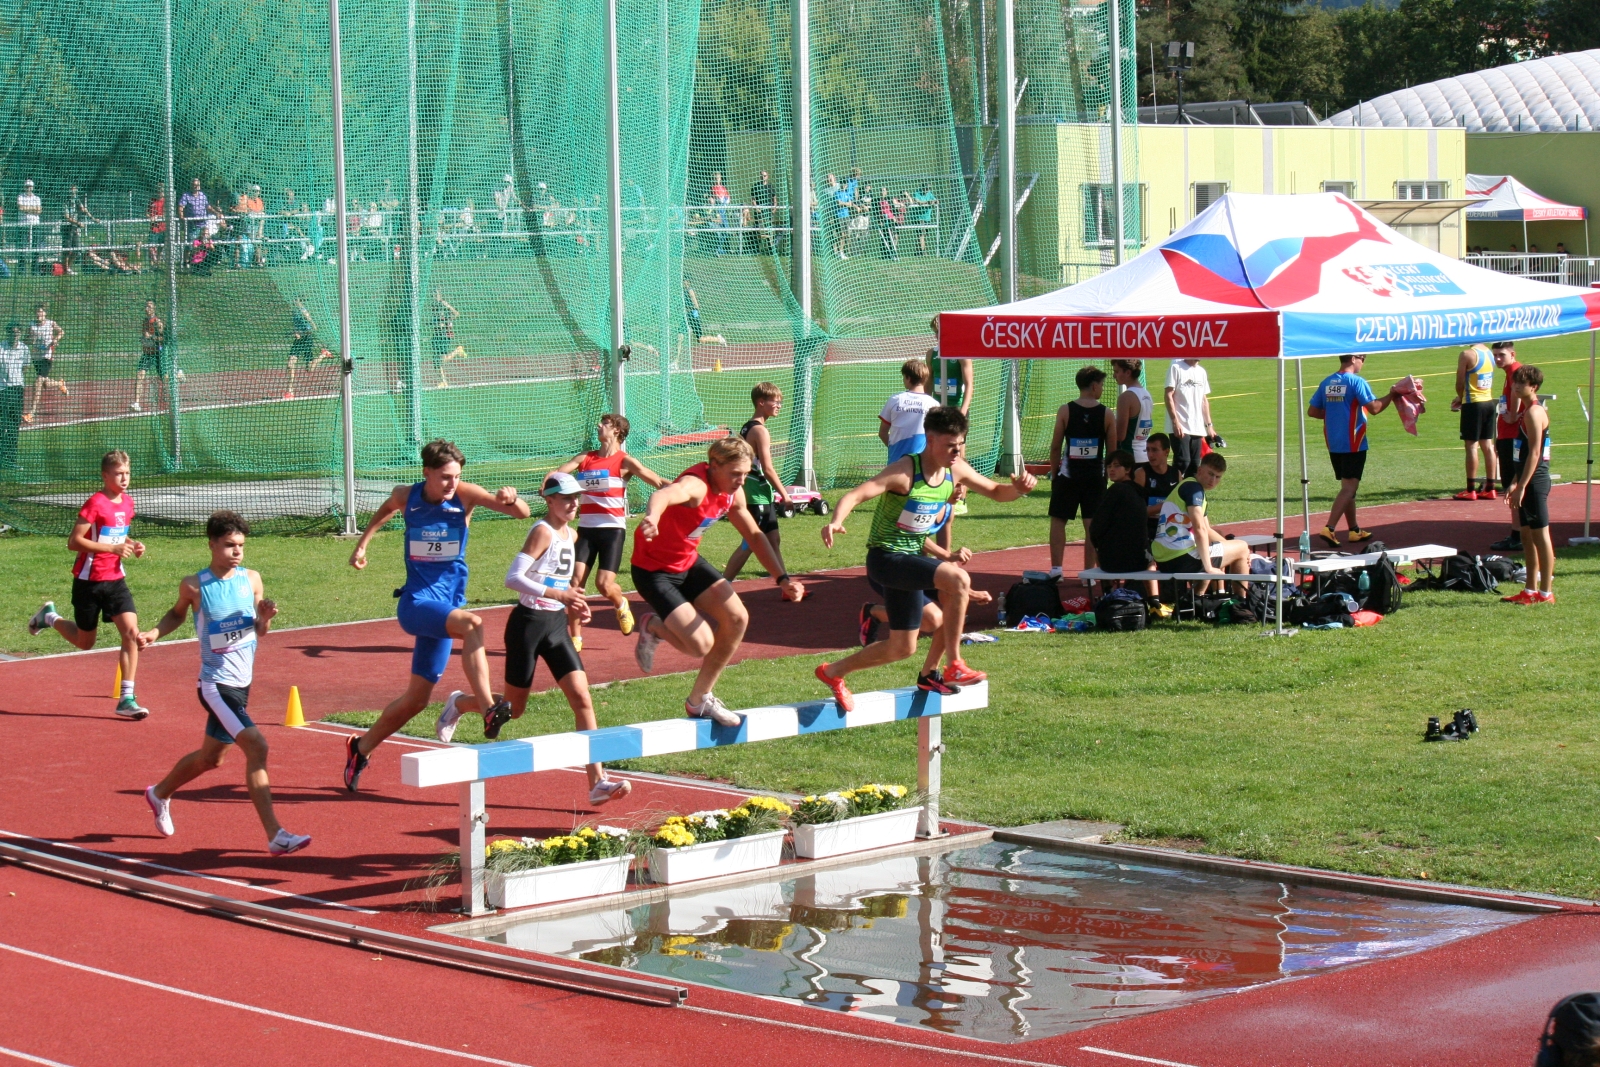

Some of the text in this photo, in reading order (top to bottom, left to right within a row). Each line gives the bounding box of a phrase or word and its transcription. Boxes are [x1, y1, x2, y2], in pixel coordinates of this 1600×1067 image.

[1390, 264, 1421, 274] ČESKÝ
[1402, 272, 1451, 284] ATLETICKÝ
[1413, 284, 1441, 293] SVAZ
[1355, 303, 1562, 343] CZECH ATHLETIC FEDERATION
[980, 316, 1228, 348] ČESKÝ ATLETICKÝ SVAZ
[1328, 385, 1341, 393] 548
[1079, 447, 1090, 455] 15
[585, 479, 600, 487] 544
[913, 514, 932, 523] 452
[427, 542, 442, 551] 78
[554, 548, 572, 576] S
[219, 619, 238, 628] ČESKÁ
[223, 629, 243, 642] 181
